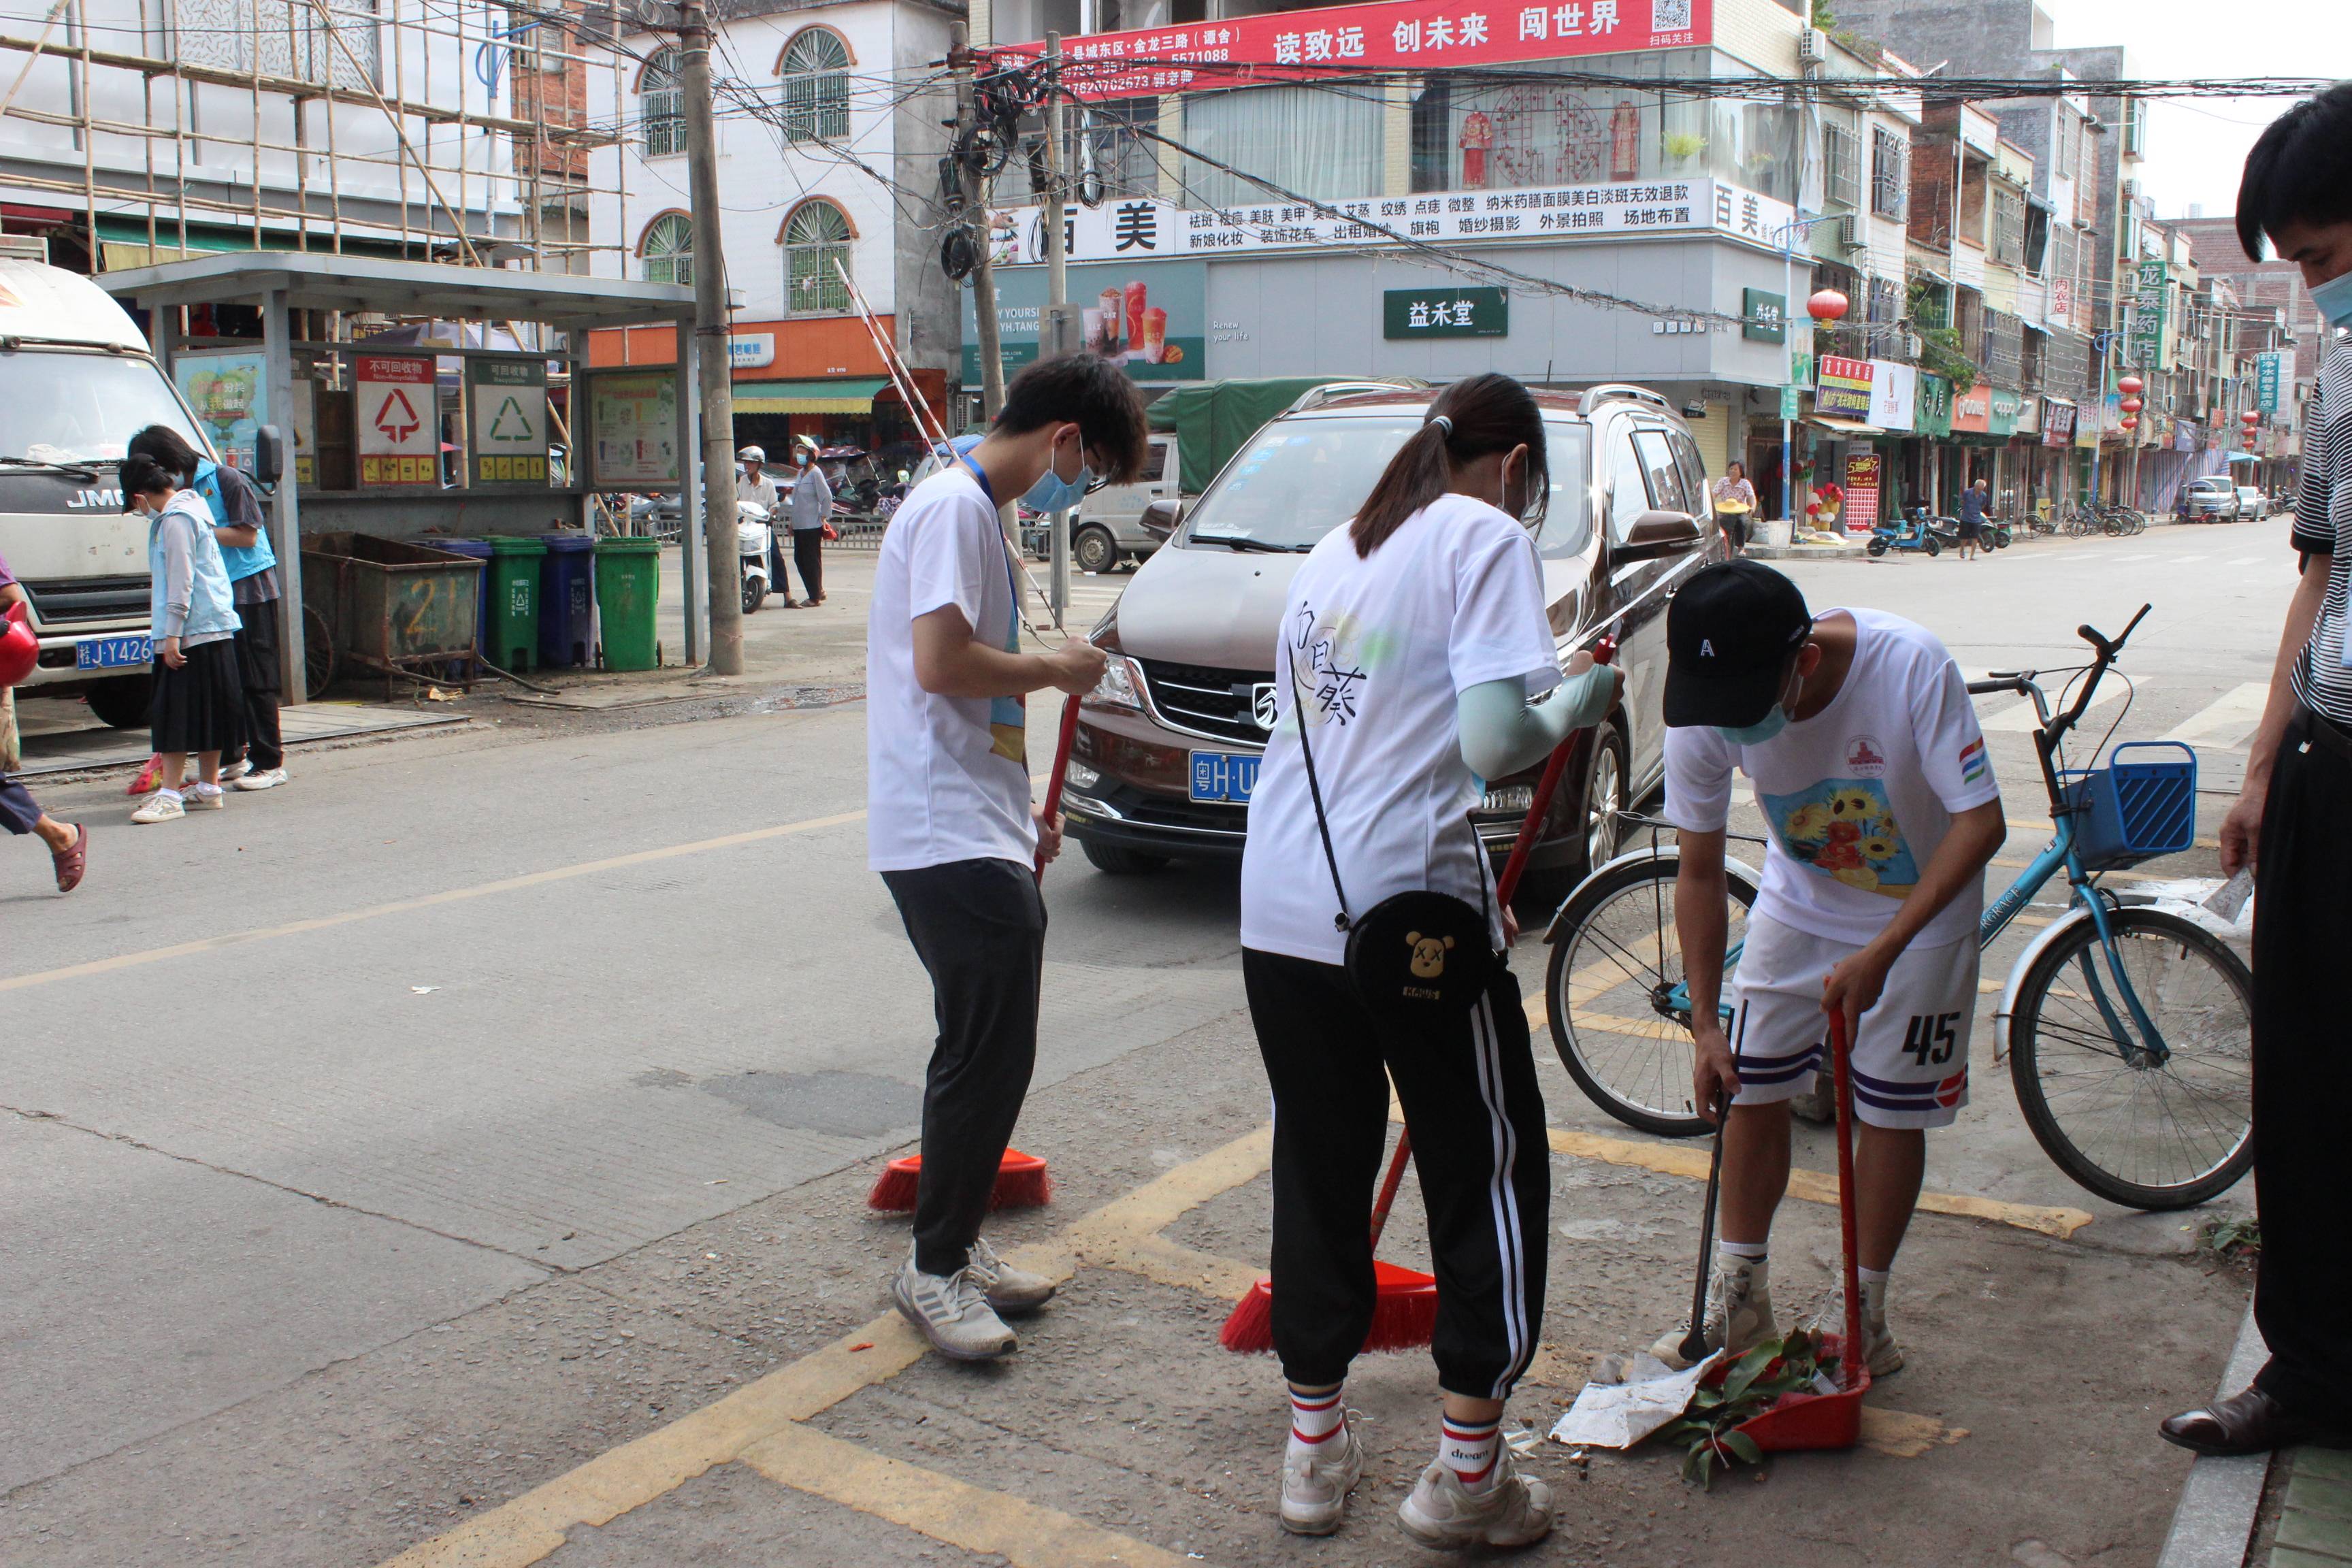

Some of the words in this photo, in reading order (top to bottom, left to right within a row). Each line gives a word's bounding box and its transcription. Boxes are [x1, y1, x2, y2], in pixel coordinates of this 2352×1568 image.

[1274, 27, 1365, 65] 读致远
[1392, 12, 1489, 53] 创未来
[1519, 0, 1620, 40] 闯世界
[1649, 32, 1695, 46] 扫码关注
[1171, 48, 1228, 67] 5571088
[1190, 213, 1213, 229] 祛斑
[1250, 209, 1274, 225] 美肤
[1281, 207, 1305, 223] 美甲
[1380, 200, 1407, 217] 纹绣
[1415, 199, 1441, 215] 点痣
[1448, 197, 1475, 213] 微整
[1486, 184, 1688, 211] 纳米药膳面膜美白淡斑无效退款
[1716, 184, 1759, 236] 百美
[1190, 230, 1244, 249] 新娘化妆
[1260, 226, 1316, 244] 装饰花车
[1334, 222, 1394, 239] 出租婚纱
[1409, 220, 1440, 238] 旗袍
[1458, 215, 1520, 234] 婚纱摄影
[1539, 212, 1604, 229] 外景拍照
[1624, 207, 1690, 225] 场地布置
[2054, 279, 2070, 313] 内衣店
[1004, 307, 1040, 318] YOURS
[1408, 299, 1475, 327] 益禾堂
[2136, 264, 2162, 359] 龙泰药店
[1213, 321, 1239, 329] Renew
[1213, 335, 1230, 344] your
[1235, 332, 1249, 340] life
[370, 361, 423, 374] 不可回收物
[491, 364, 528, 376] 可回收物
[1701, 638, 1715, 657] A
[1196, 760, 1261, 795] 粤H·U
[1902, 1011, 1961, 1066] 45
[1451, 1448, 1489, 1460] dream
